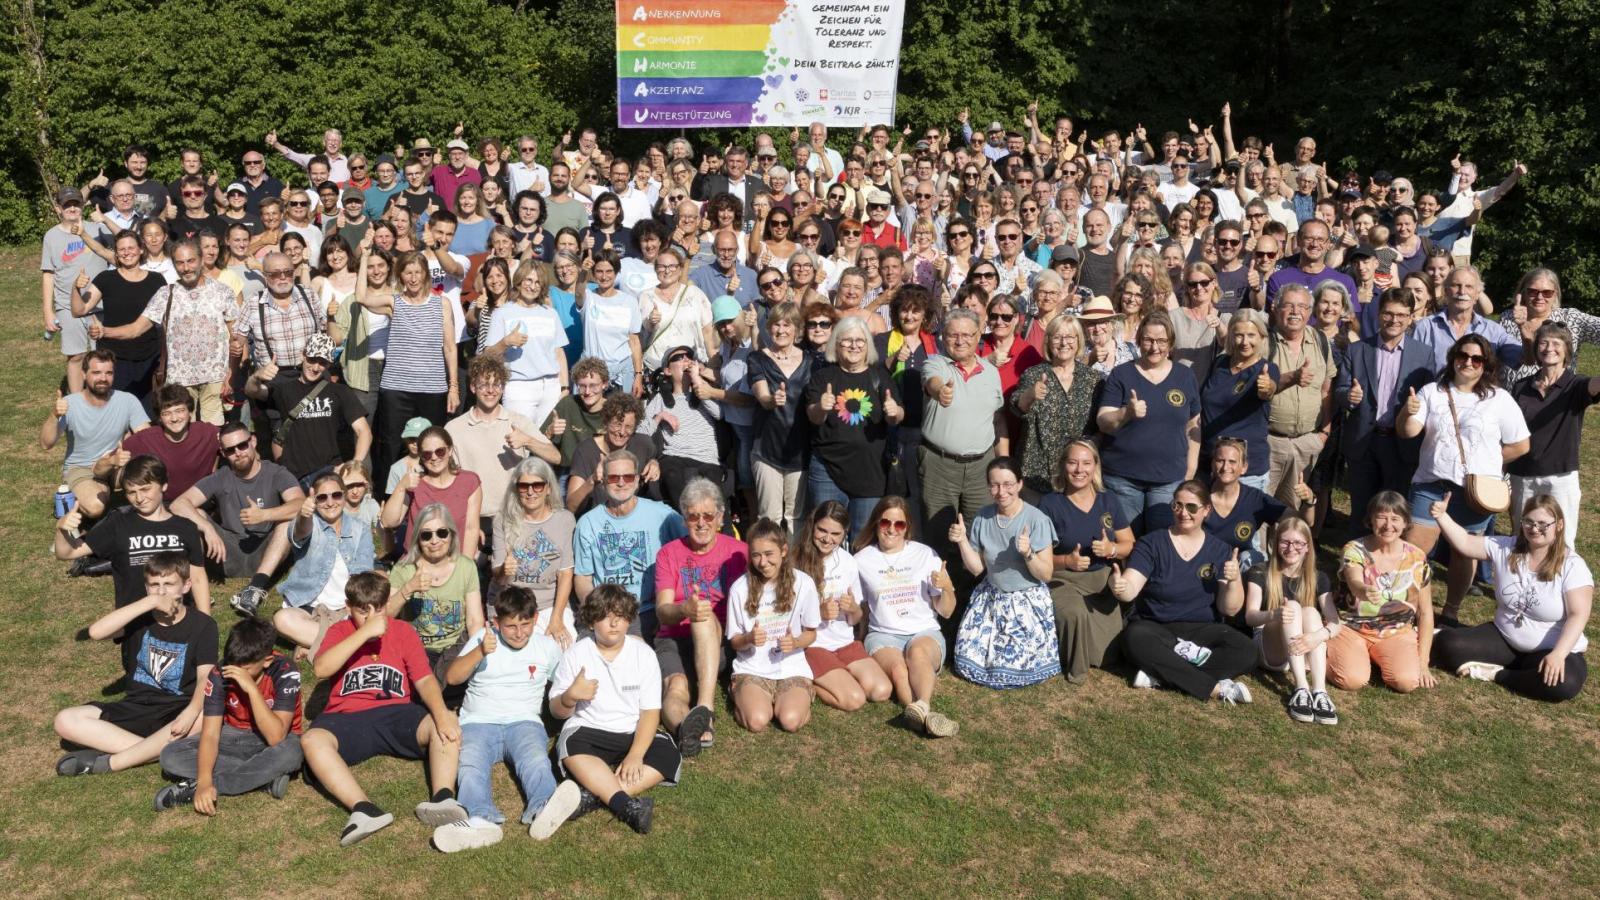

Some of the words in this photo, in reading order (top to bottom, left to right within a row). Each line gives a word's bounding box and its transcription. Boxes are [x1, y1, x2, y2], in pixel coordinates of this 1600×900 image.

[633, 5, 721, 21] ANERKENNUNG
[812, 4, 870, 13] GEMEINSAM
[873, 5, 890, 13] EIN
[819, 15, 861, 25] ZEICHEN
[815, 27, 865, 37] TOLERANZ
[868, 29, 887, 37] UND
[632, 31, 704, 48] COMMUNITY
[828, 39, 873, 49] RESPEKT.
[633, 56, 697, 73] HARMONIE
[794, 59, 817, 68] DEIN
[820, 59, 863, 69] BEITRAG
[865, 58, 895, 69] ZÄHLT!
[634, 82, 704, 97] AKZEPTANZ
[634, 107, 732, 123] UNTERSTÜTZUNG
[843, 106, 861, 115] KJR
[129, 534, 184, 550] NOPE.
